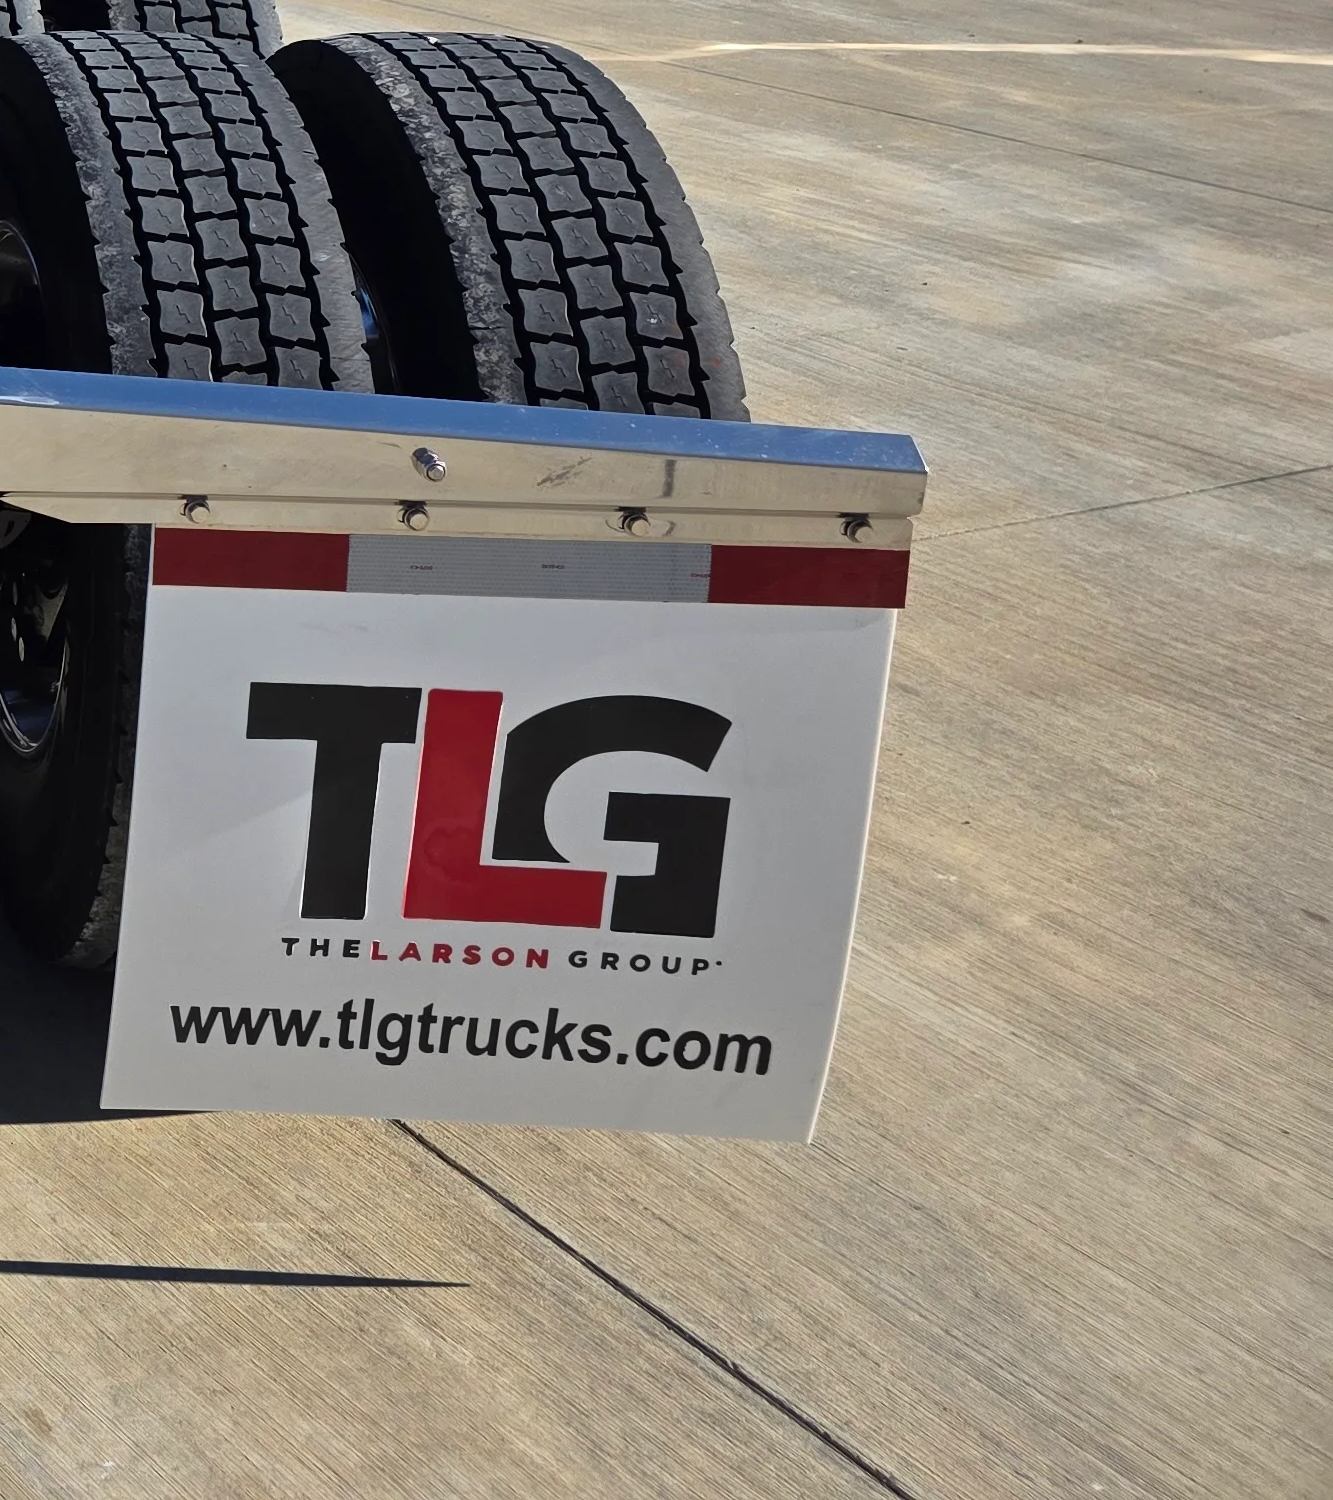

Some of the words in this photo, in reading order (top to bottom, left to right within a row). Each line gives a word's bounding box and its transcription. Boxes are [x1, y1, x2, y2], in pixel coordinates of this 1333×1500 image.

[246, 682, 732, 938] TLG
[569, 951, 709, 975] GROUP
[170, 998, 771, 1075] www.tlgtrucks.com
